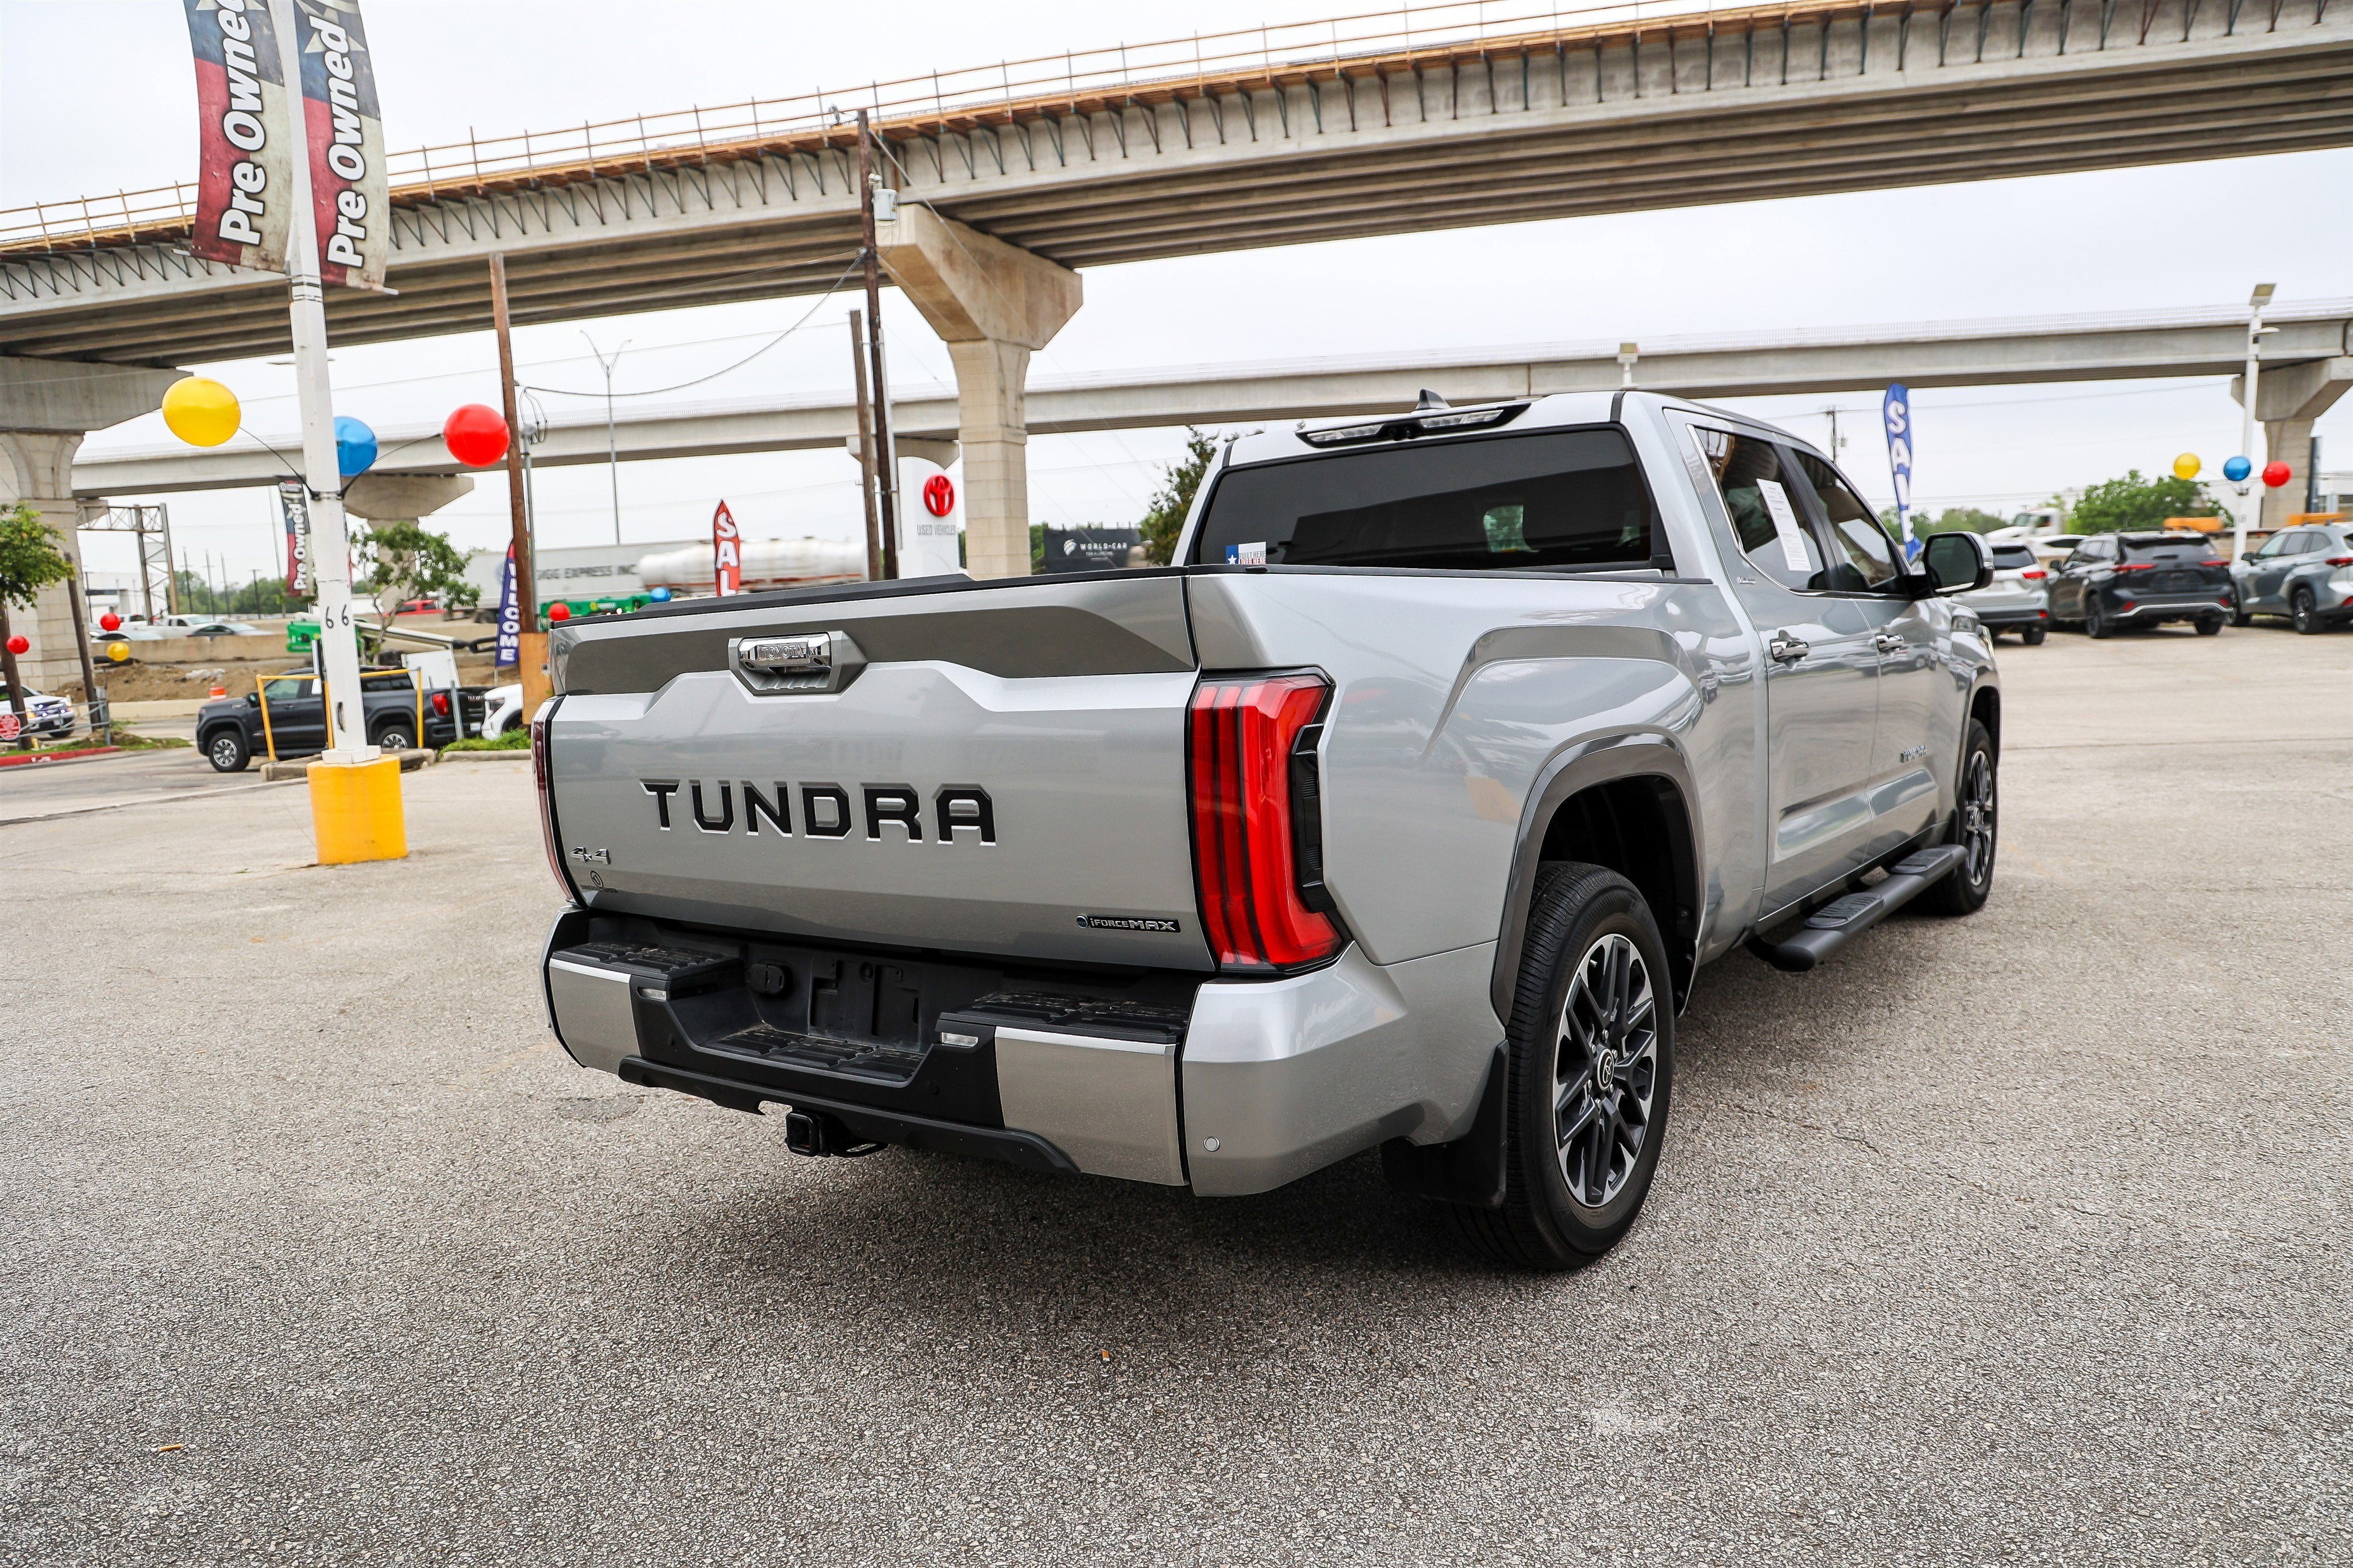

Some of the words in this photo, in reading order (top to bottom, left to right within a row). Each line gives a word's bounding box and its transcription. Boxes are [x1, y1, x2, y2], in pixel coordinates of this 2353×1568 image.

[308, 15, 365, 181] Owned
[219, 162, 267, 245] Pre
[327, 191, 367, 268] Pre
[288, 503, 307, 561] Owned
[917, 524, 932, 535] USED
[934, 523, 956, 535] VEHICLES
[1253, 550, 1266, 558] HERE
[293, 562, 308, 590] Pre
[499, 562, 520, 661] LCOME
[761, 644, 805, 659] TOYOTA
[639, 779, 997, 847] TUNDRA
[570, 845, 611, 865] 4x4
